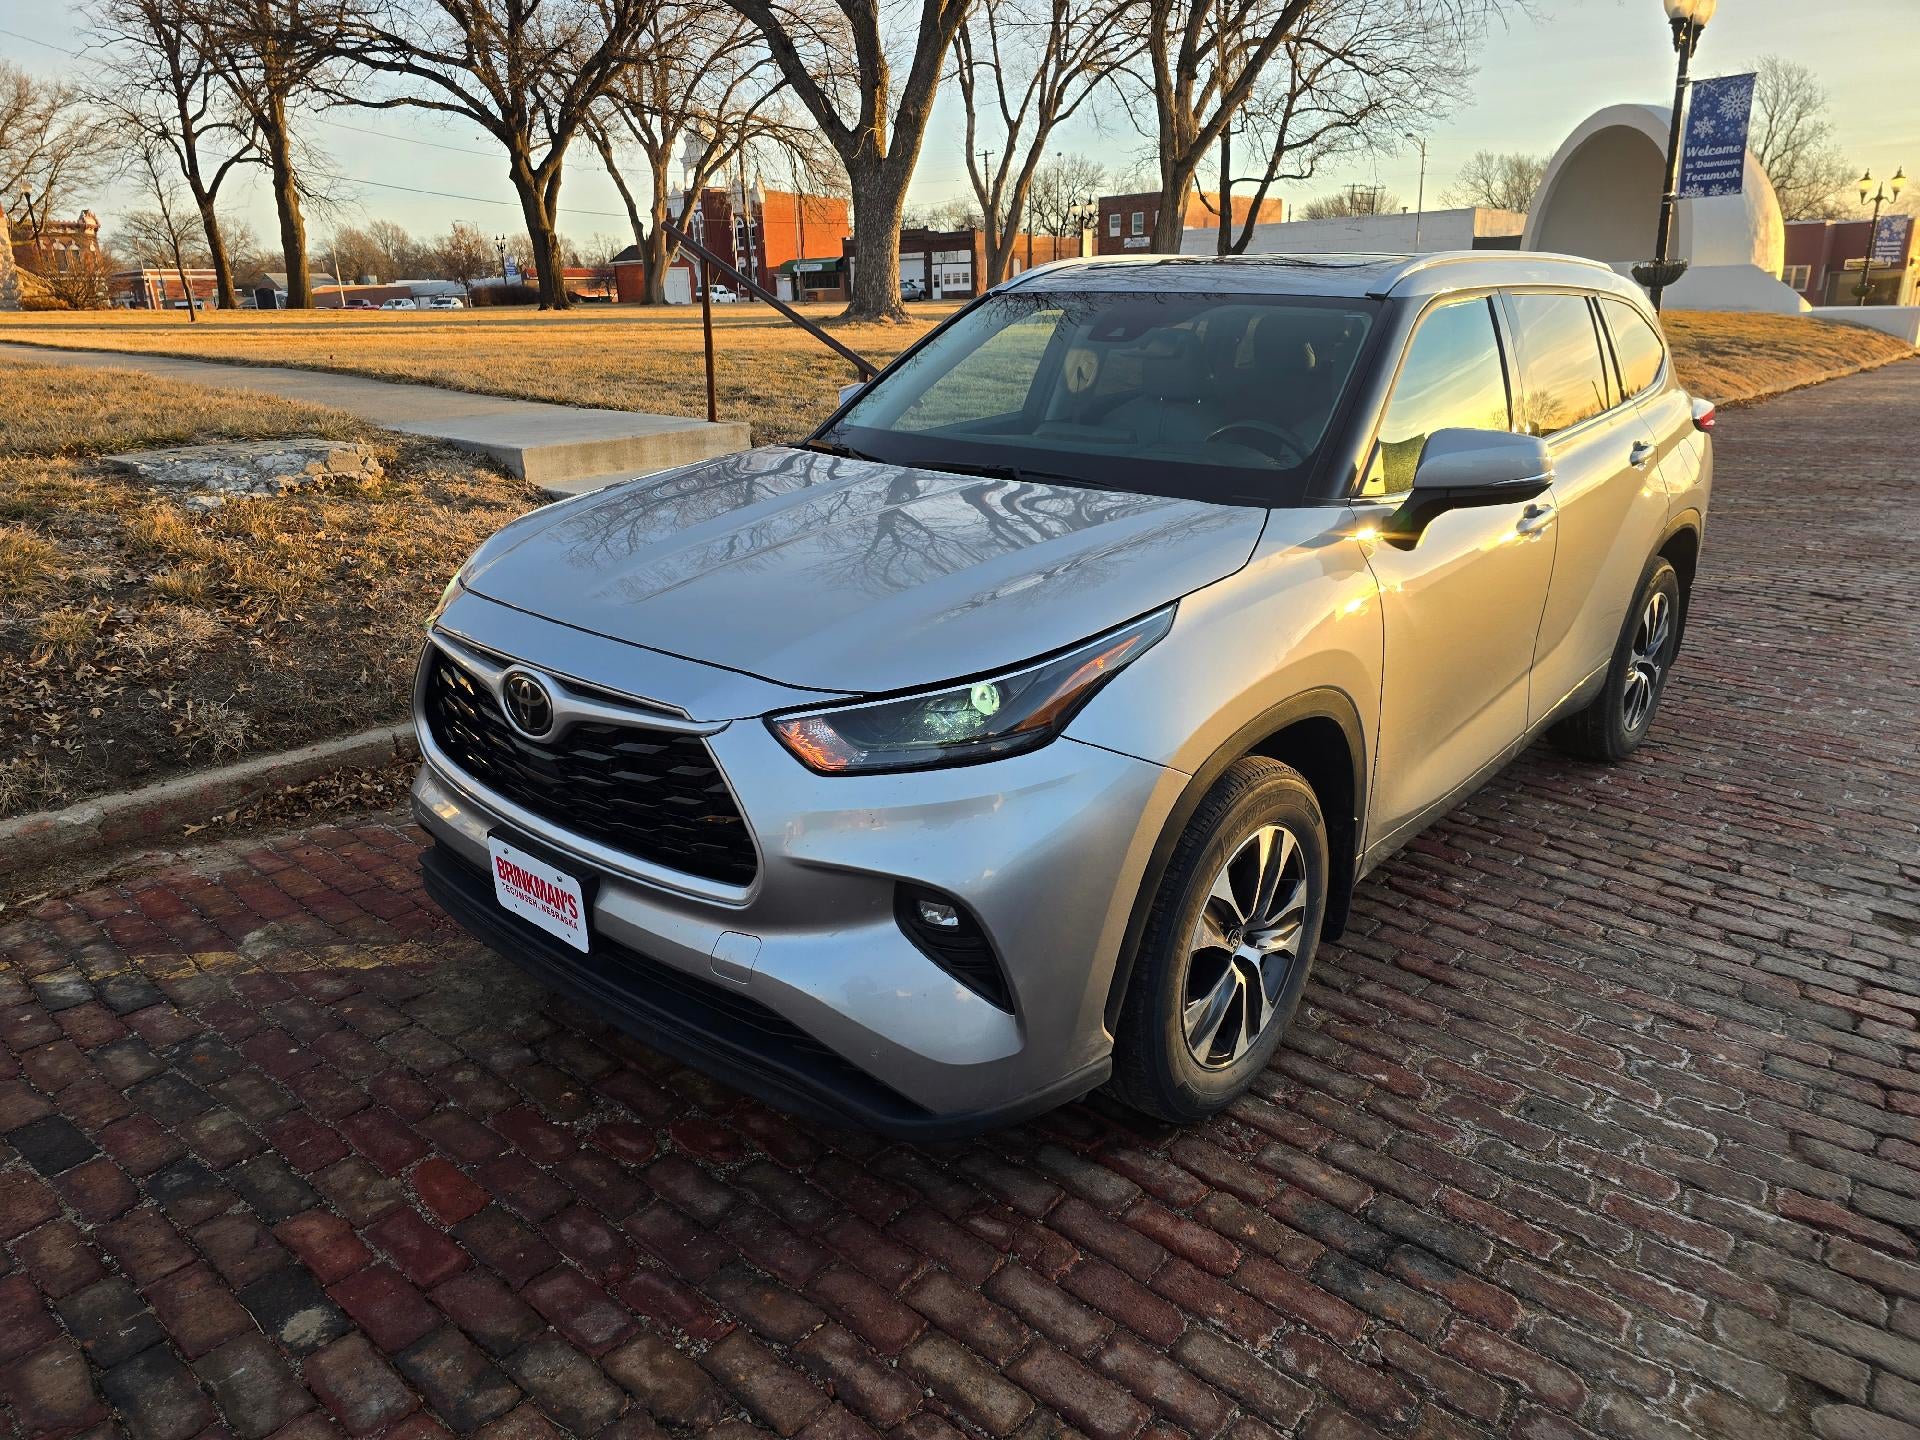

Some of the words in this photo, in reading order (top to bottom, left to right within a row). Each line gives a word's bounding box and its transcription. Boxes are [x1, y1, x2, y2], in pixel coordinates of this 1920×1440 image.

[1686, 145, 1741, 157] Welcome
[1695, 159, 1741, 168] Downtown
[1685, 168, 1740, 182] Tecumseh
[496, 856, 578, 919] BRINKMAN'S
[541, 904, 579, 931] NEBRASKA
